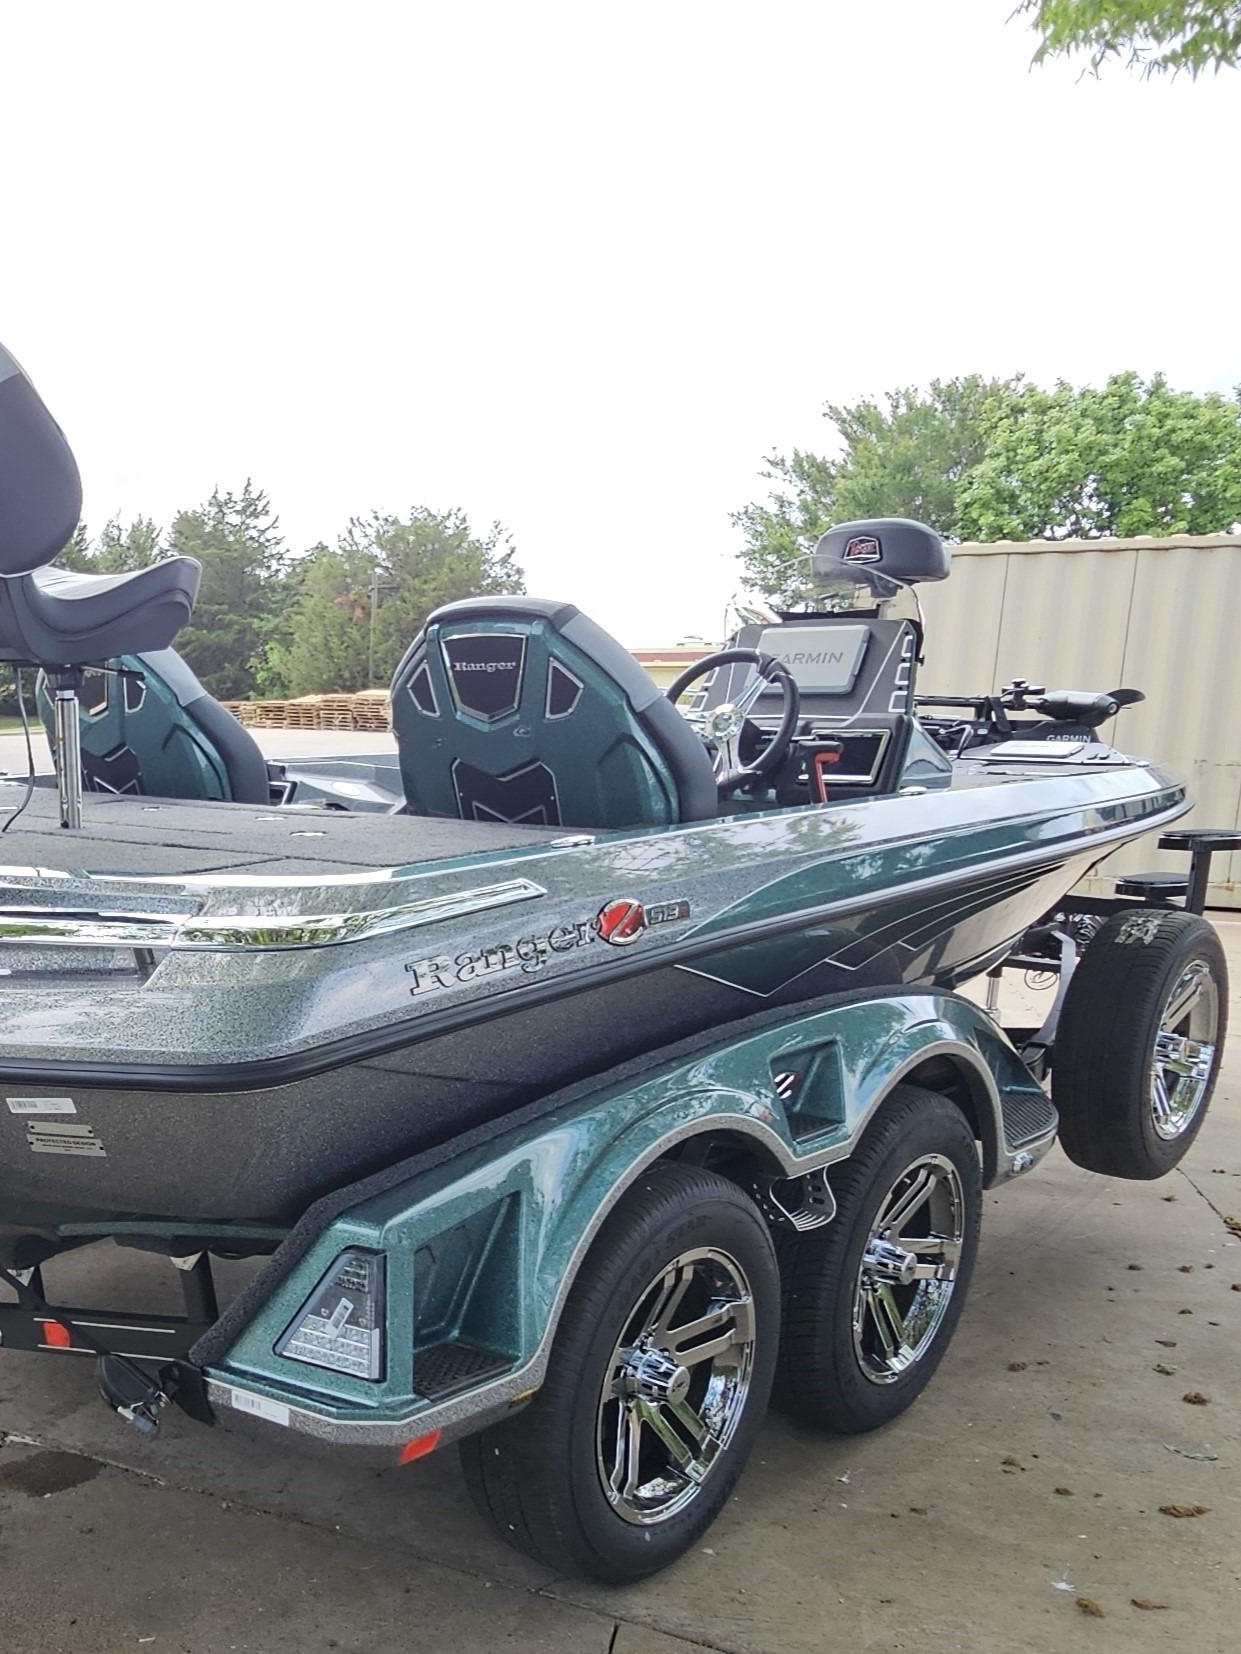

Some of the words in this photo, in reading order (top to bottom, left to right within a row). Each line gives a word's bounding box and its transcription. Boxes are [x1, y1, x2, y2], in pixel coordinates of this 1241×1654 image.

[453, 661, 517, 673] Ranger
[1046, 734, 1091, 744] GARMIN
[404, 916, 601, 997] Ranger
